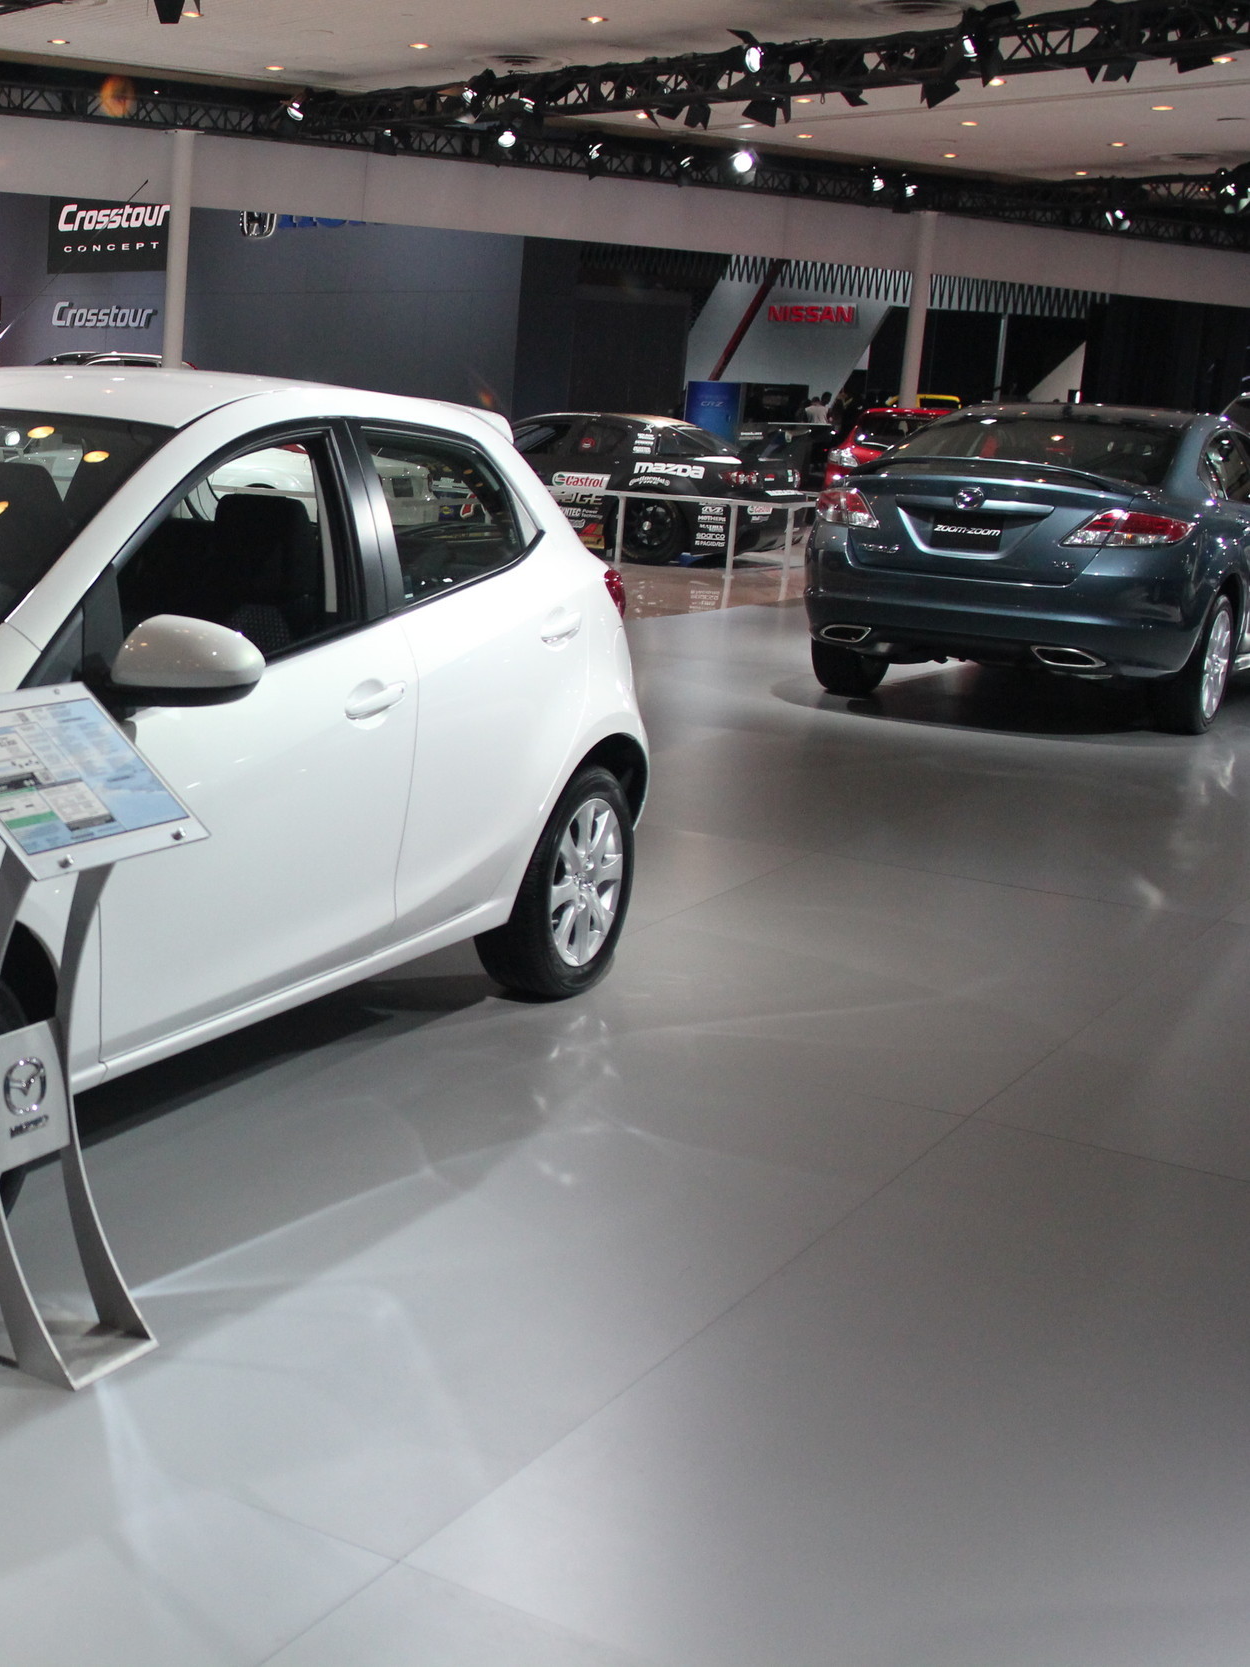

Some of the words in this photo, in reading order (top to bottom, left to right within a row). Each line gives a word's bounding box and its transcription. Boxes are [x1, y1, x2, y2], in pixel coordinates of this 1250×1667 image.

[58, 203, 171, 232] Crosstour
[63, 241, 160, 253] CONCEPT
[52, 301, 154, 328] Crosstour
[767, 305, 857, 323] NISSAN
[633, 461, 706, 480] mazda
[565, 473, 604, 489] Castrol
[934, 524, 1001, 537] zoom-zoom
